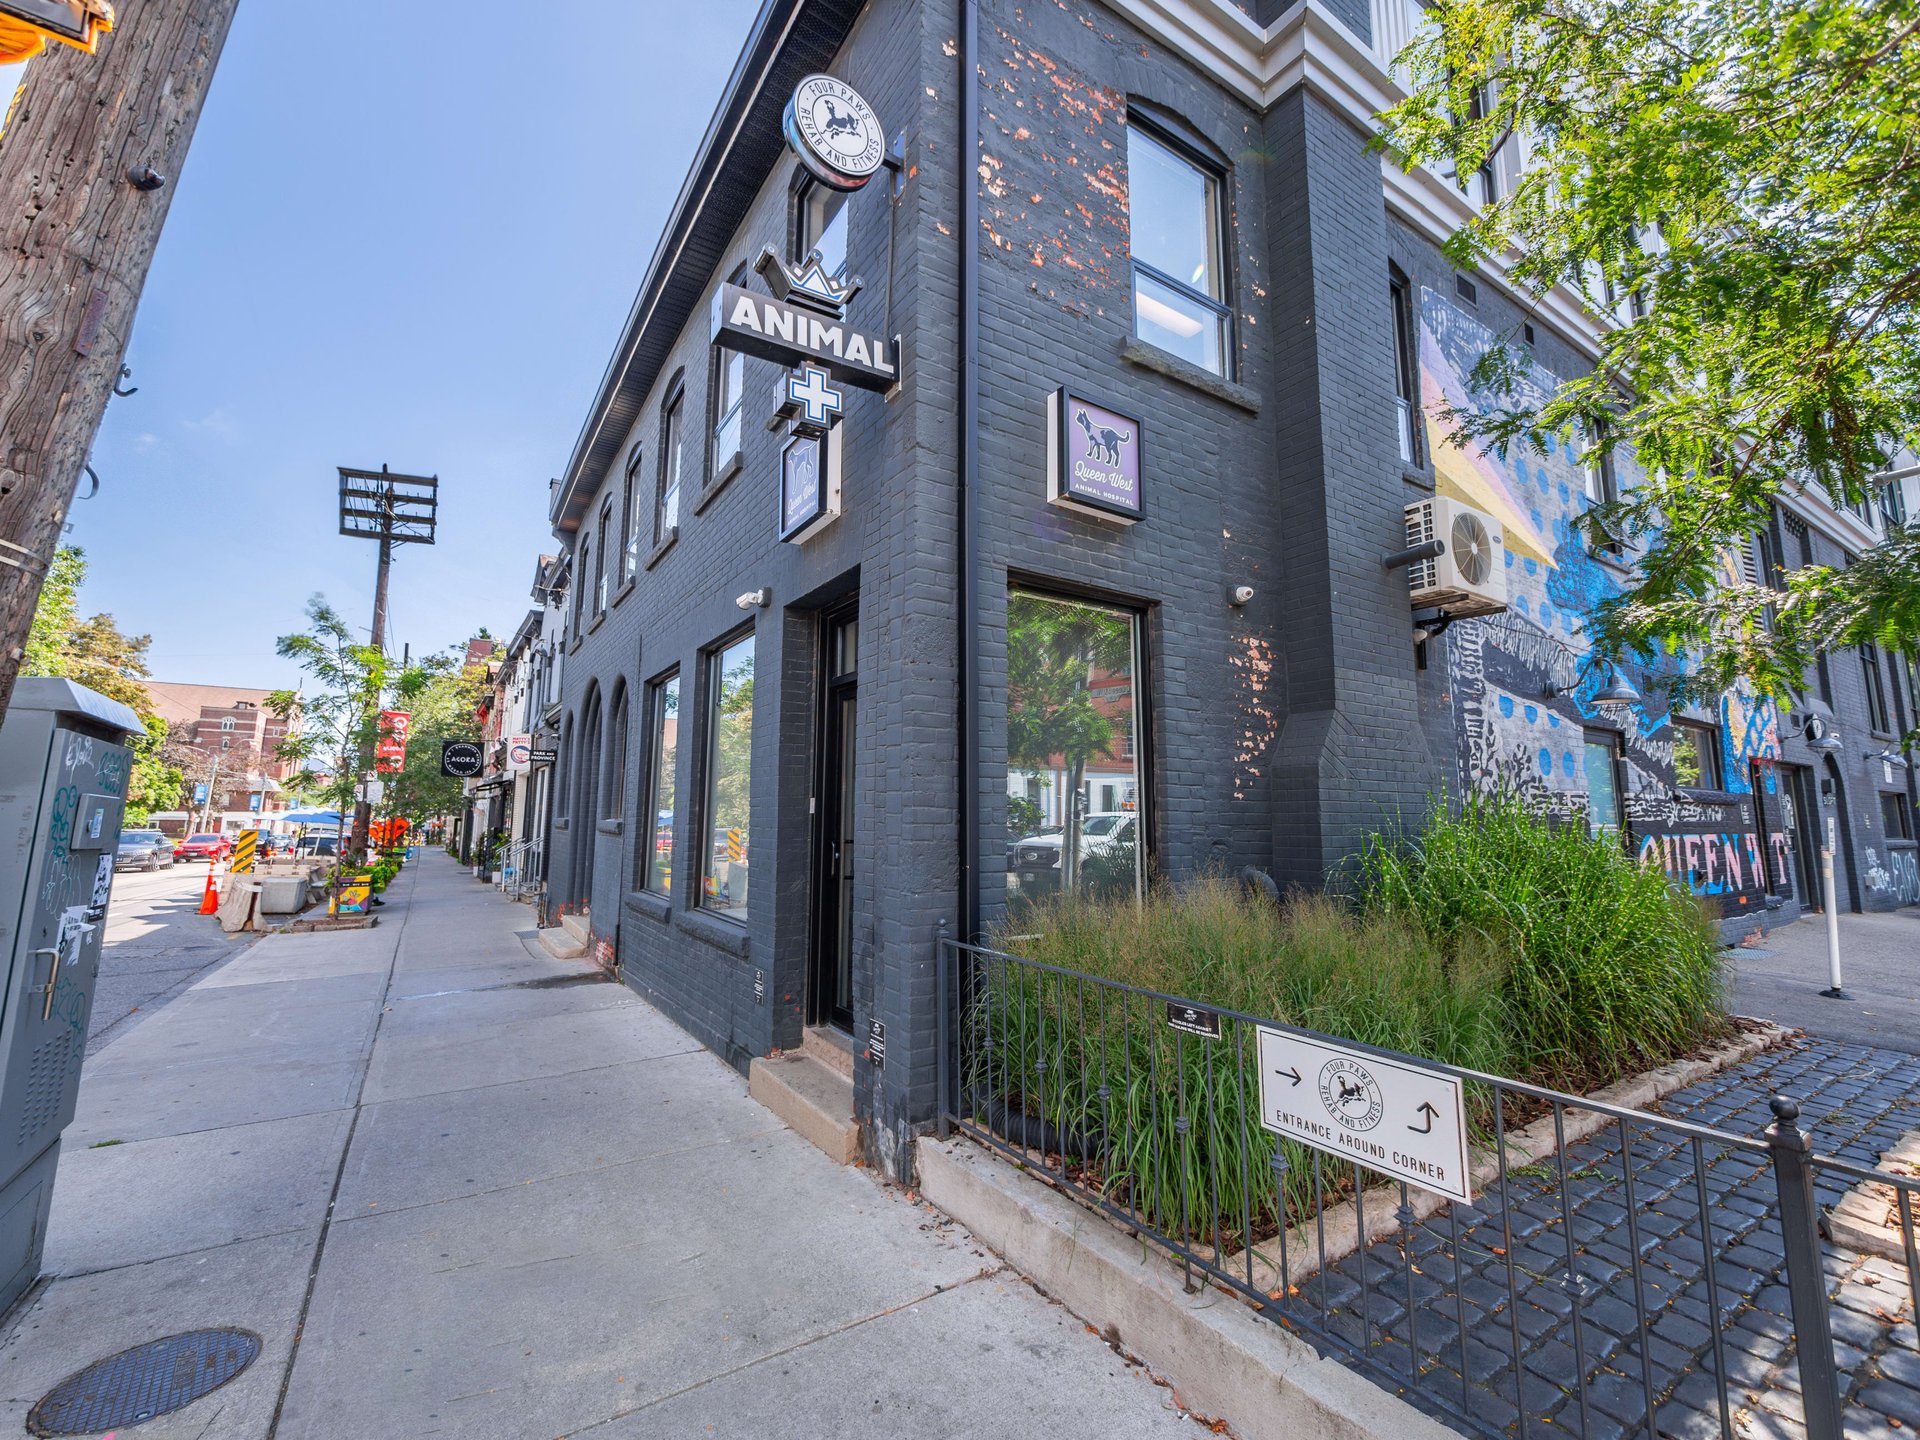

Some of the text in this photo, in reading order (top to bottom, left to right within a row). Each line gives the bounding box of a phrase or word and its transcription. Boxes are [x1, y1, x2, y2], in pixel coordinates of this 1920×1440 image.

[808, 81, 871, 120] FOUR PAWS
[800, 107, 880, 169] REHAB AND FITNESS
[730, 296, 894, 374] ANIMAL
[1074, 460, 1134, 492] Queen West
[1074, 483, 1134, 506] ANIMAL HOSPITAL
[1639, 833, 1743, 896] QUEEN
[1325, 1060, 1373, 1086] FOUR PAWS
[1320, 1085, 1381, 1128] REHAB AND FITNESS
[1276, 1109, 1445, 1181] ENTRANCE AROUND CORNER
